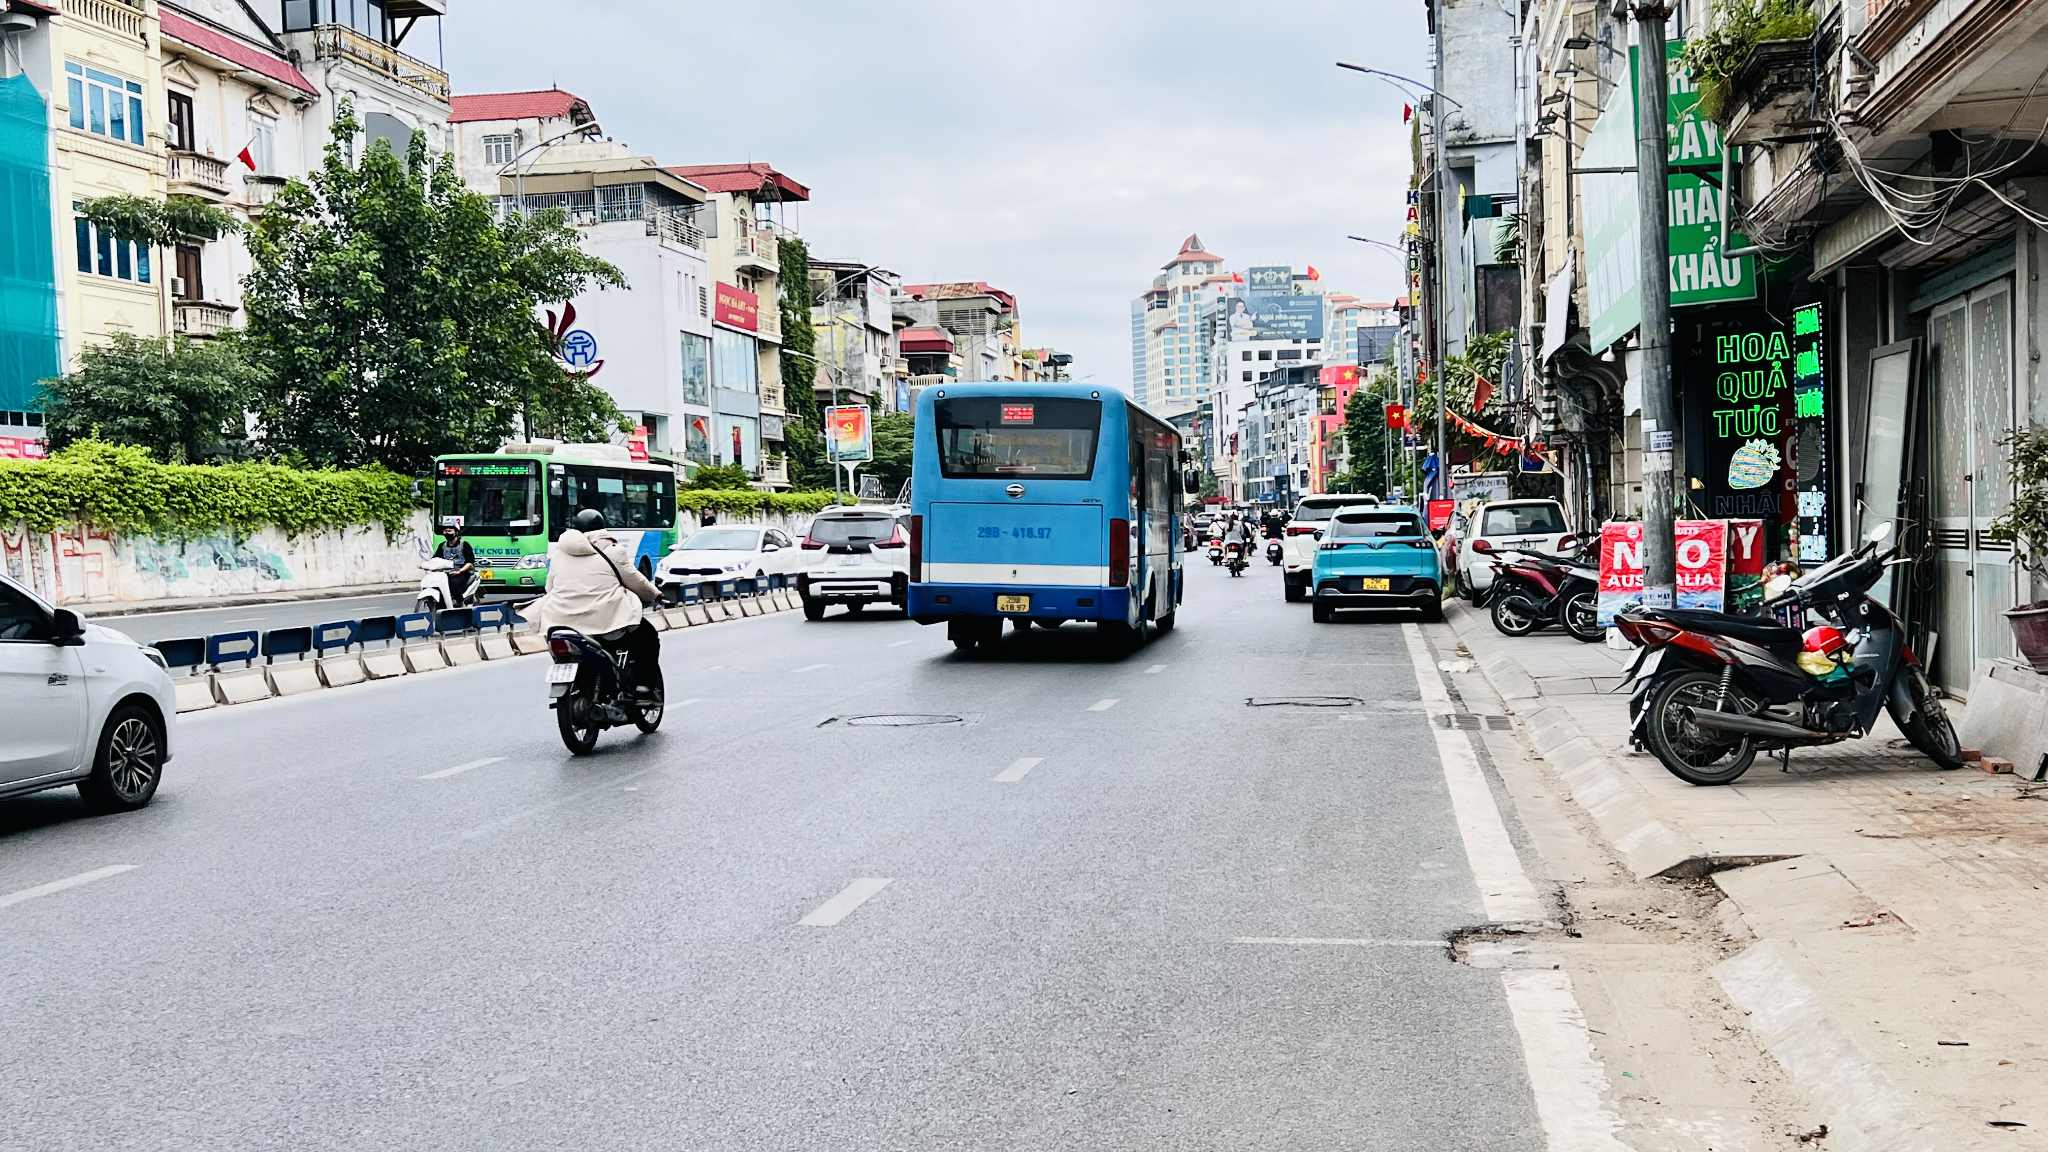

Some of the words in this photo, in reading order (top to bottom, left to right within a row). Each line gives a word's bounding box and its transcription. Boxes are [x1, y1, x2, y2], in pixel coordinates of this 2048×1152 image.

[1668, 179, 1724, 232] HẬ
[1717, 331, 1790, 364] HOA
[1717, 360, 1788, 403] QUẢ
[1712, 403, 1782, 438] TƯƠ
[1606, 571, 1717, 588] AUSALIA
